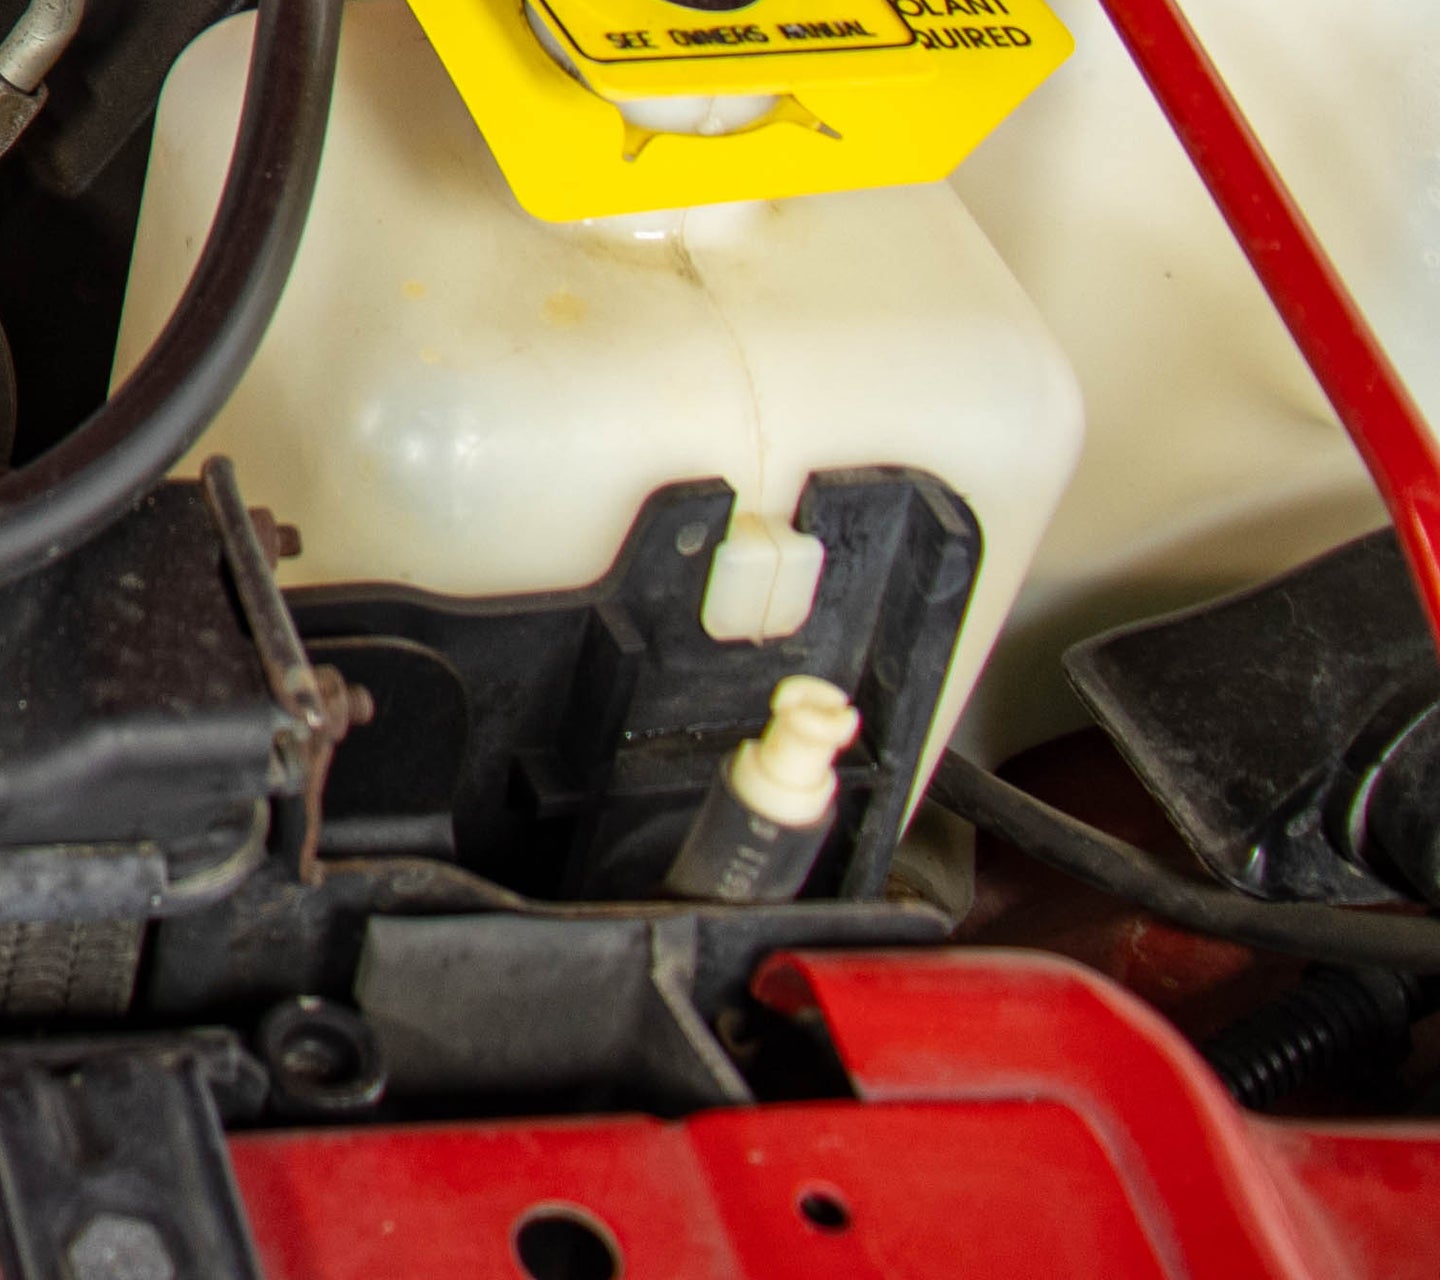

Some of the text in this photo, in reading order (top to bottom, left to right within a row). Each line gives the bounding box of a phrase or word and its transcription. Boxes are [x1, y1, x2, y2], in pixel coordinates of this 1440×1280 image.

[605, 19, 879, 50] SEE OWNERS MANUAL
